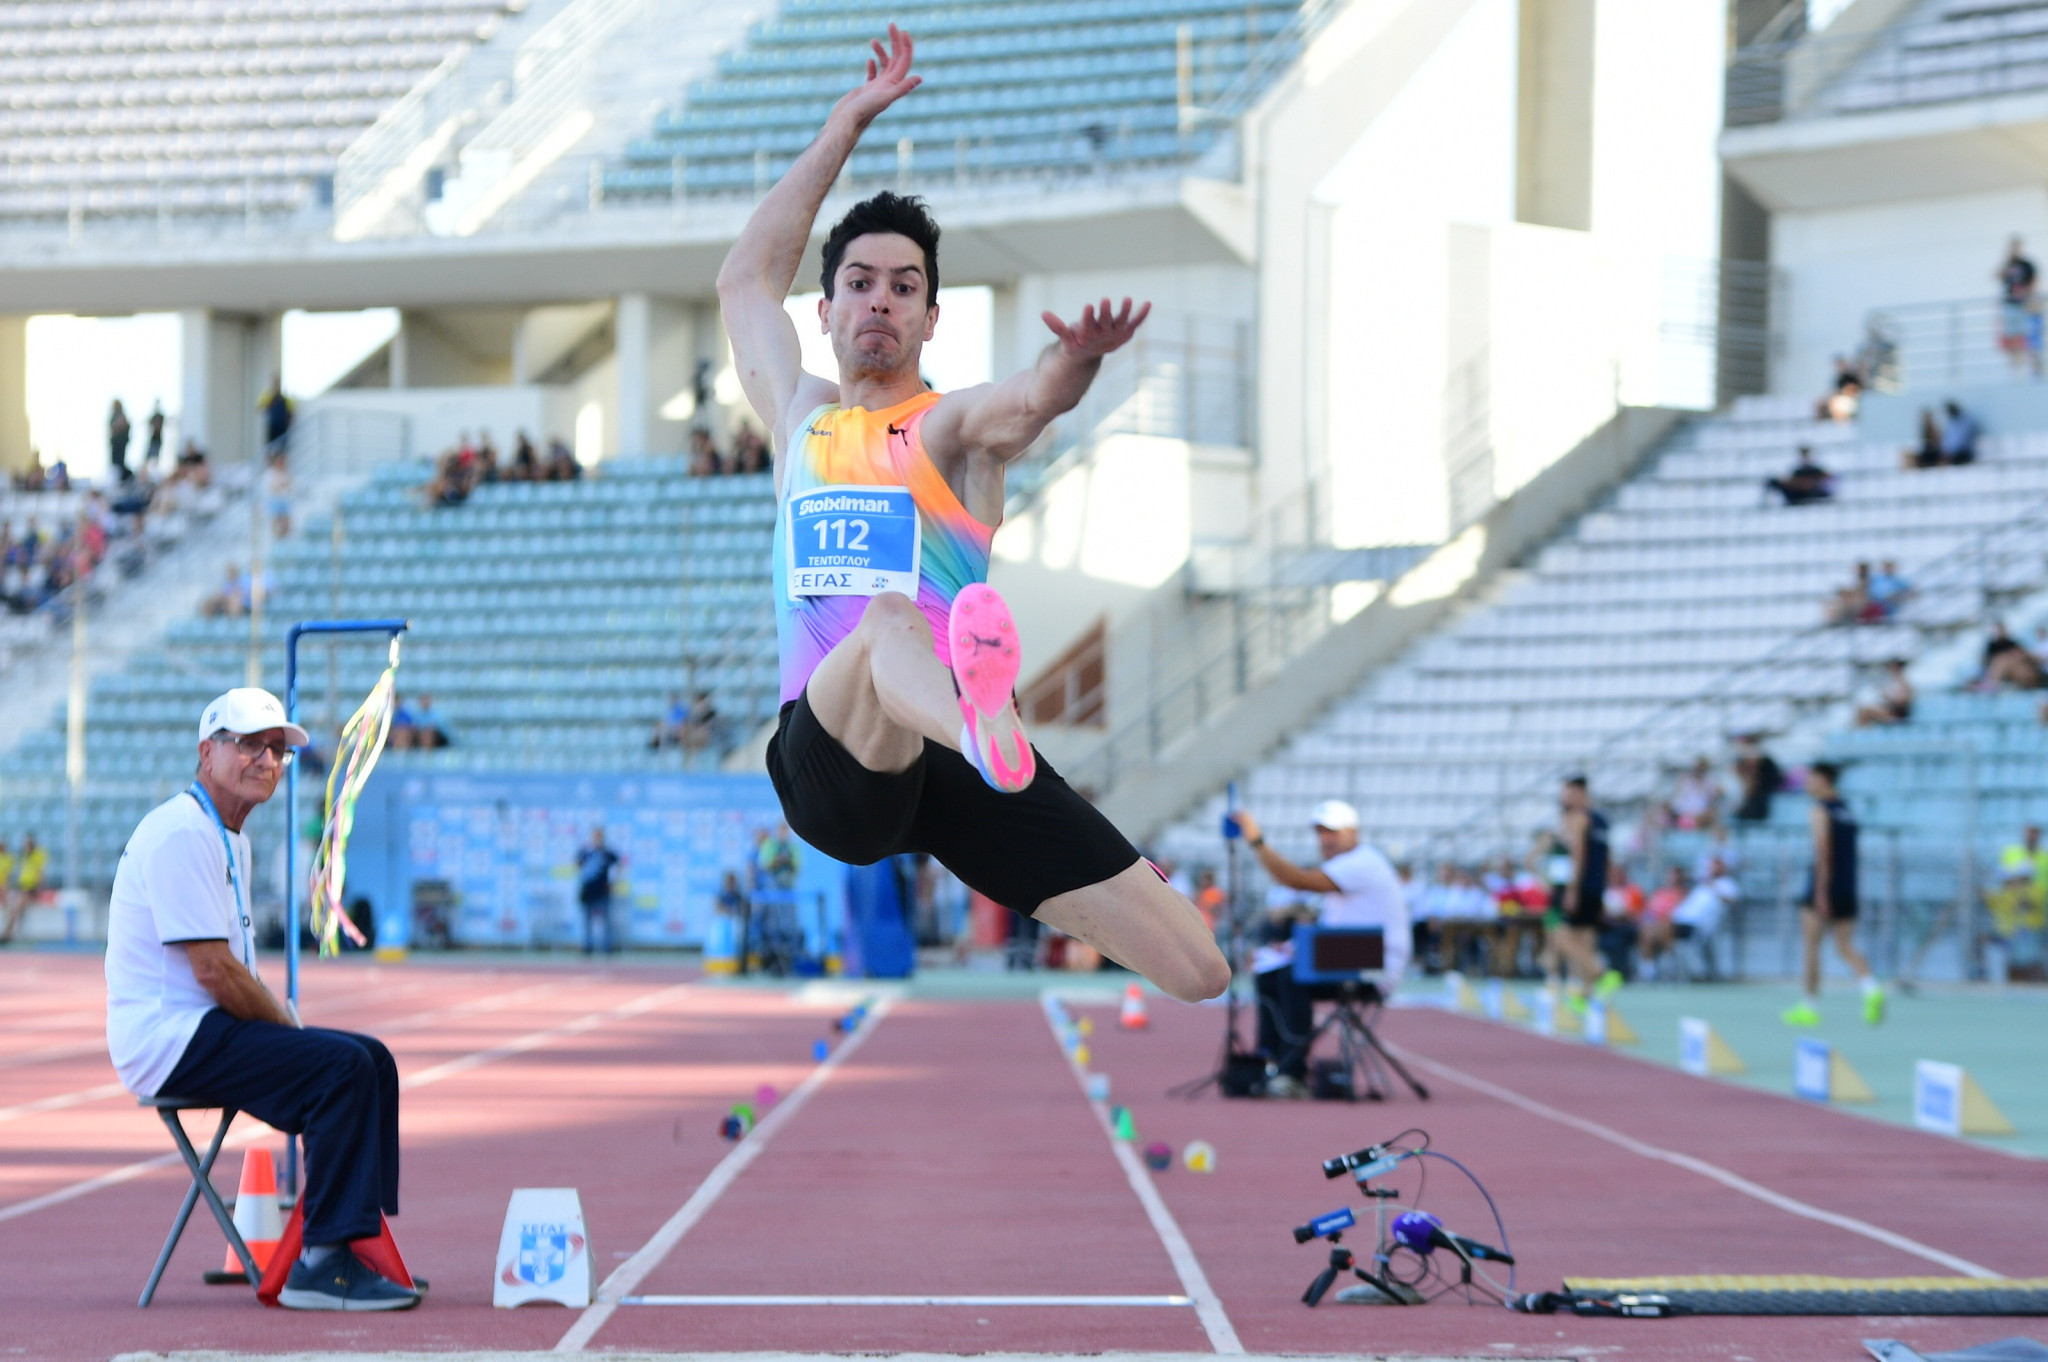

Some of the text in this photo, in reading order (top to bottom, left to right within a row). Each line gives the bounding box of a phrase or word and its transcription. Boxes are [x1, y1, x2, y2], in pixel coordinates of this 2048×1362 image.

[798, 495, 890, 516] Stoiximan
[813, 518, 870, 551] 112
[808, 555, 870, 567] ΤΕΝΤΟΓΛΟΥ
